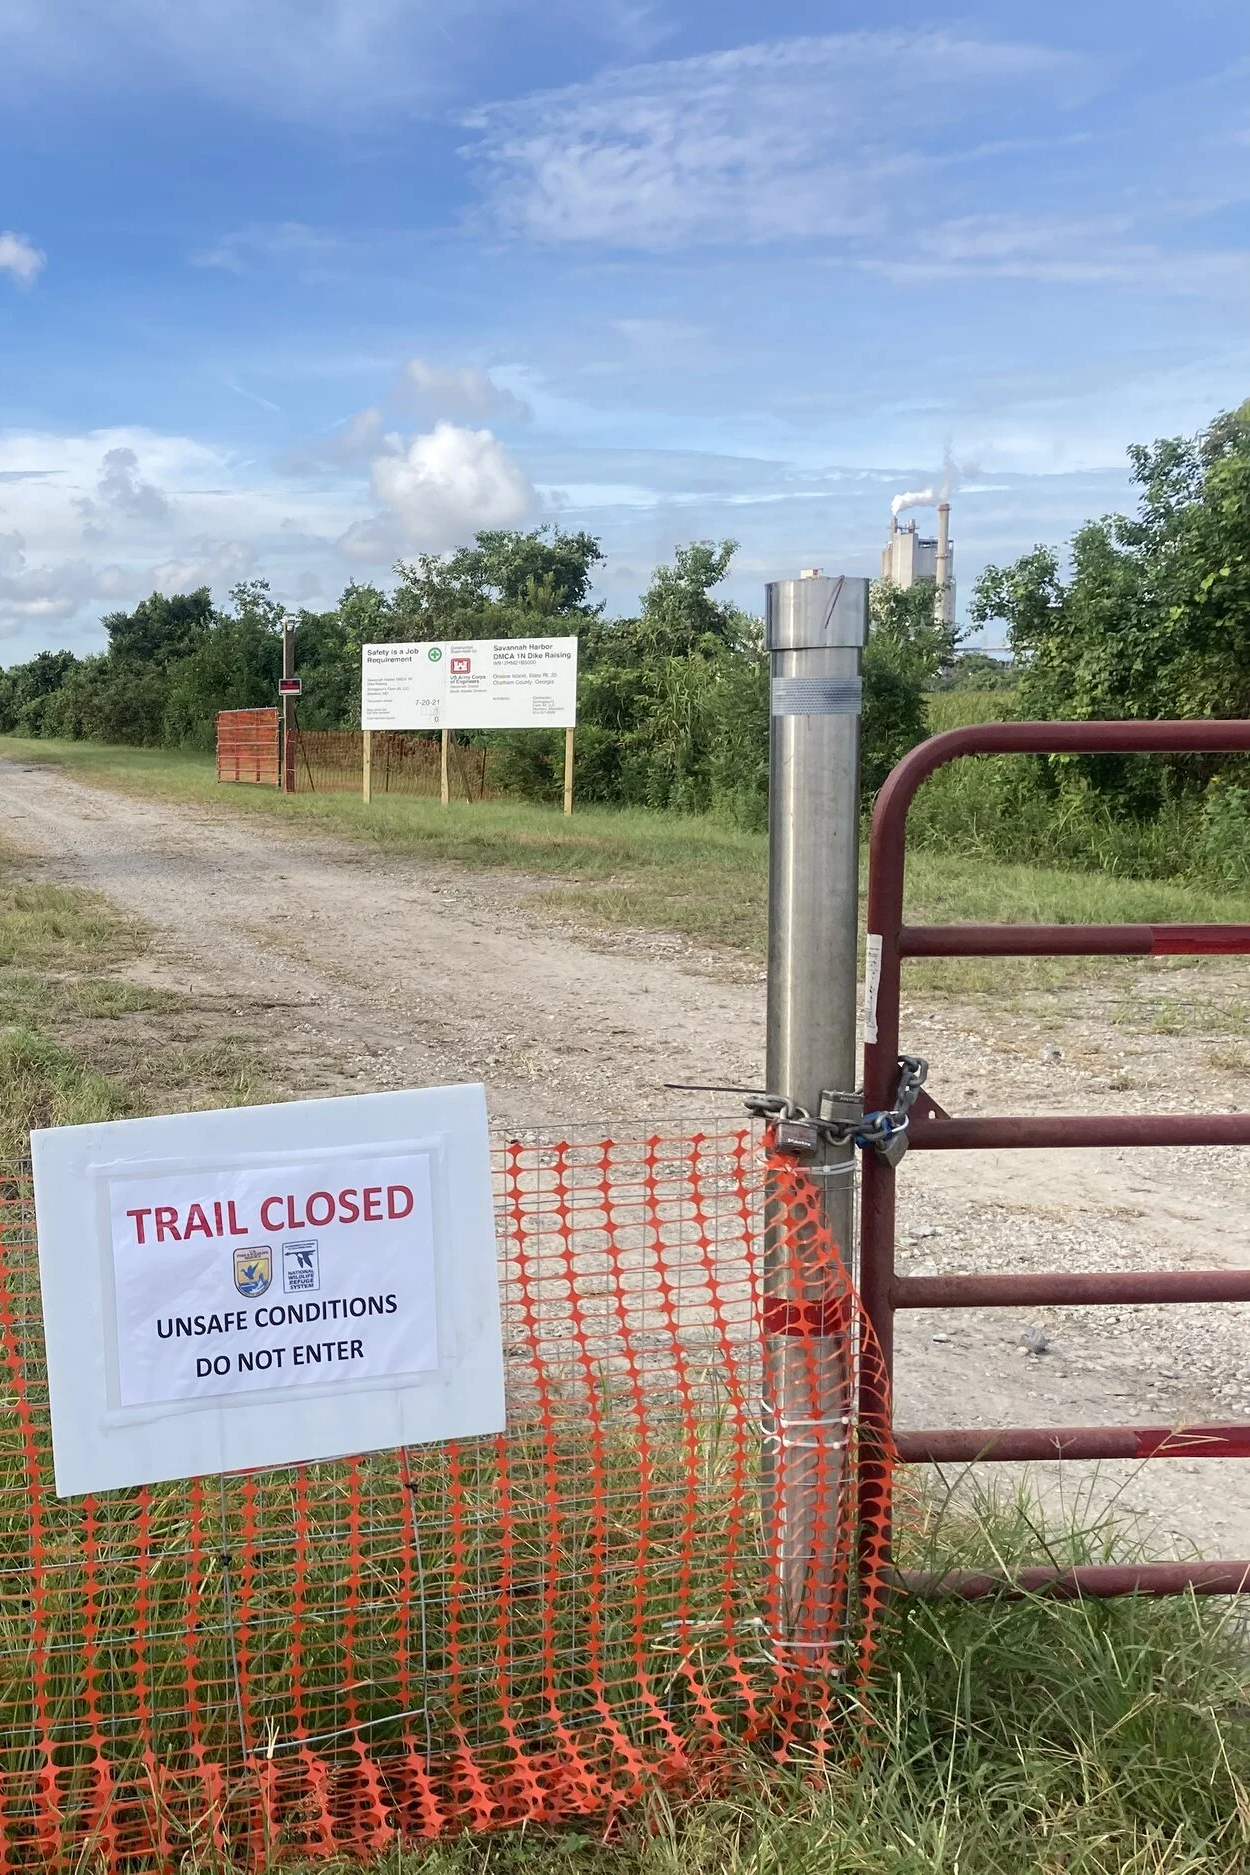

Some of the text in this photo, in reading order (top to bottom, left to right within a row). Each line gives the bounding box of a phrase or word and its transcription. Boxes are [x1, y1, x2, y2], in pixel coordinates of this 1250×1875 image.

[126, 1185, 415, 1244] TRAIL CLOSED
[156, 1294, 398, 1339] UNSAFE CONDITIONS
[196, 1339, 364, 1377] DO NOT ENTER
